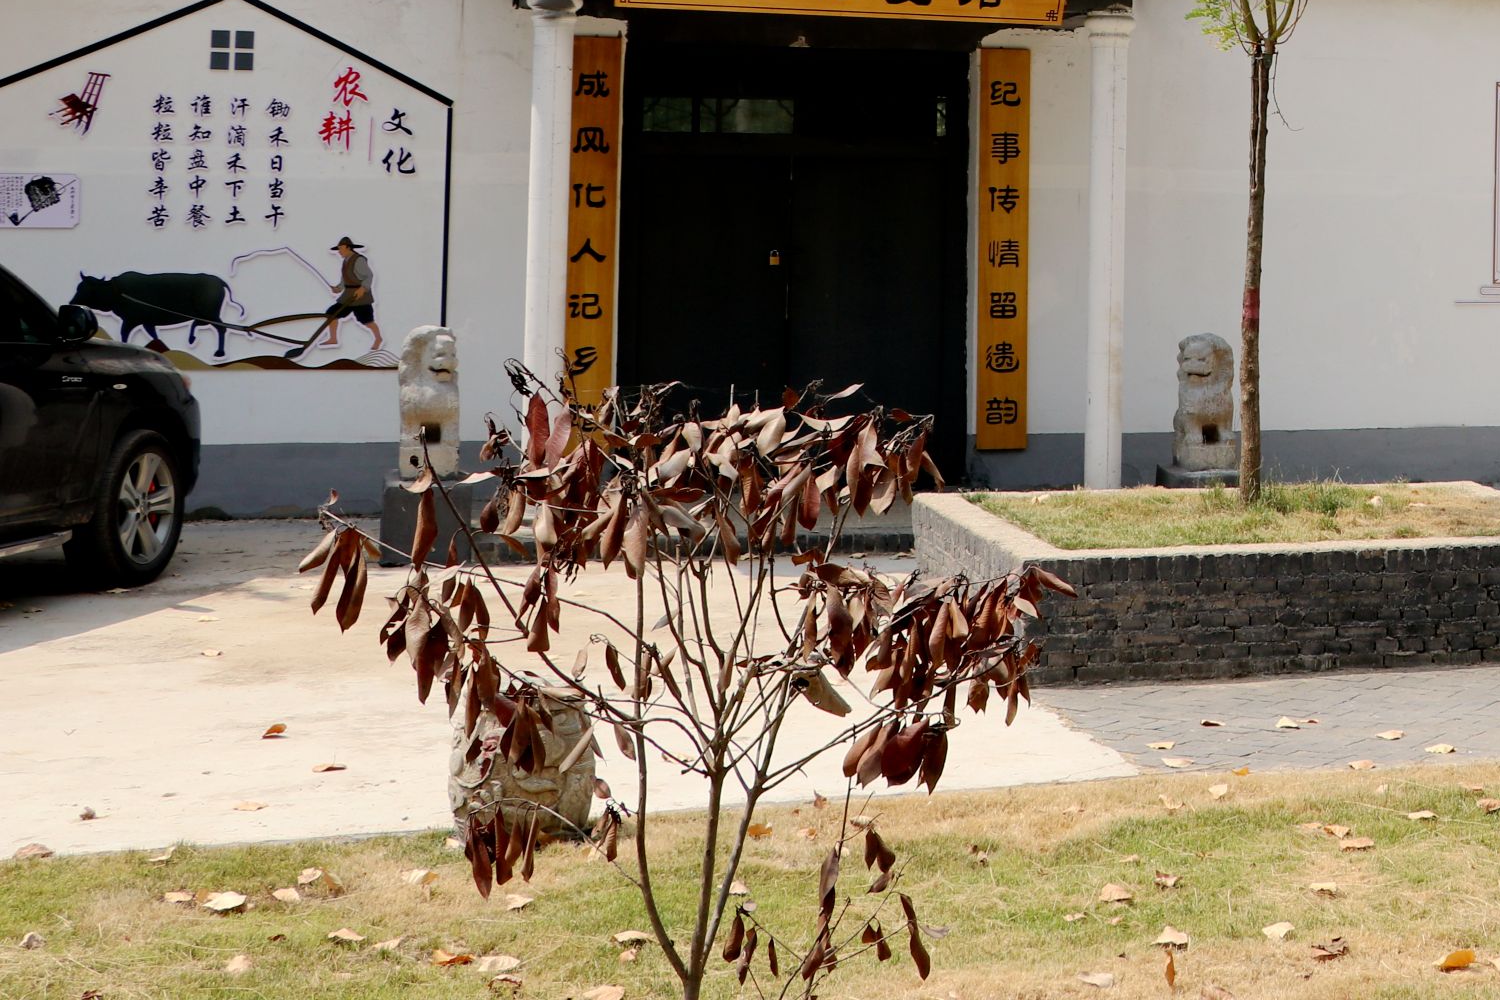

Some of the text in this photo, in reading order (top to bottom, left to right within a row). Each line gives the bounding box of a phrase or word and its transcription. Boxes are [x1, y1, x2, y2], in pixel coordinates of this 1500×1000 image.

[147, 94, 175, 228] 粒粒皆辛苦
[187, 94, 212, 228] 谁知盘中餐
[225, 97, 250, 224] 汗滴禾下土
[265, 98, 291, 228] 锄禾日当午
[319, 66, 368, 151] 农耕
[381, 108, 415, 175] 文化
[986, 80, 1022, 426] 纪事传情留遗韵
